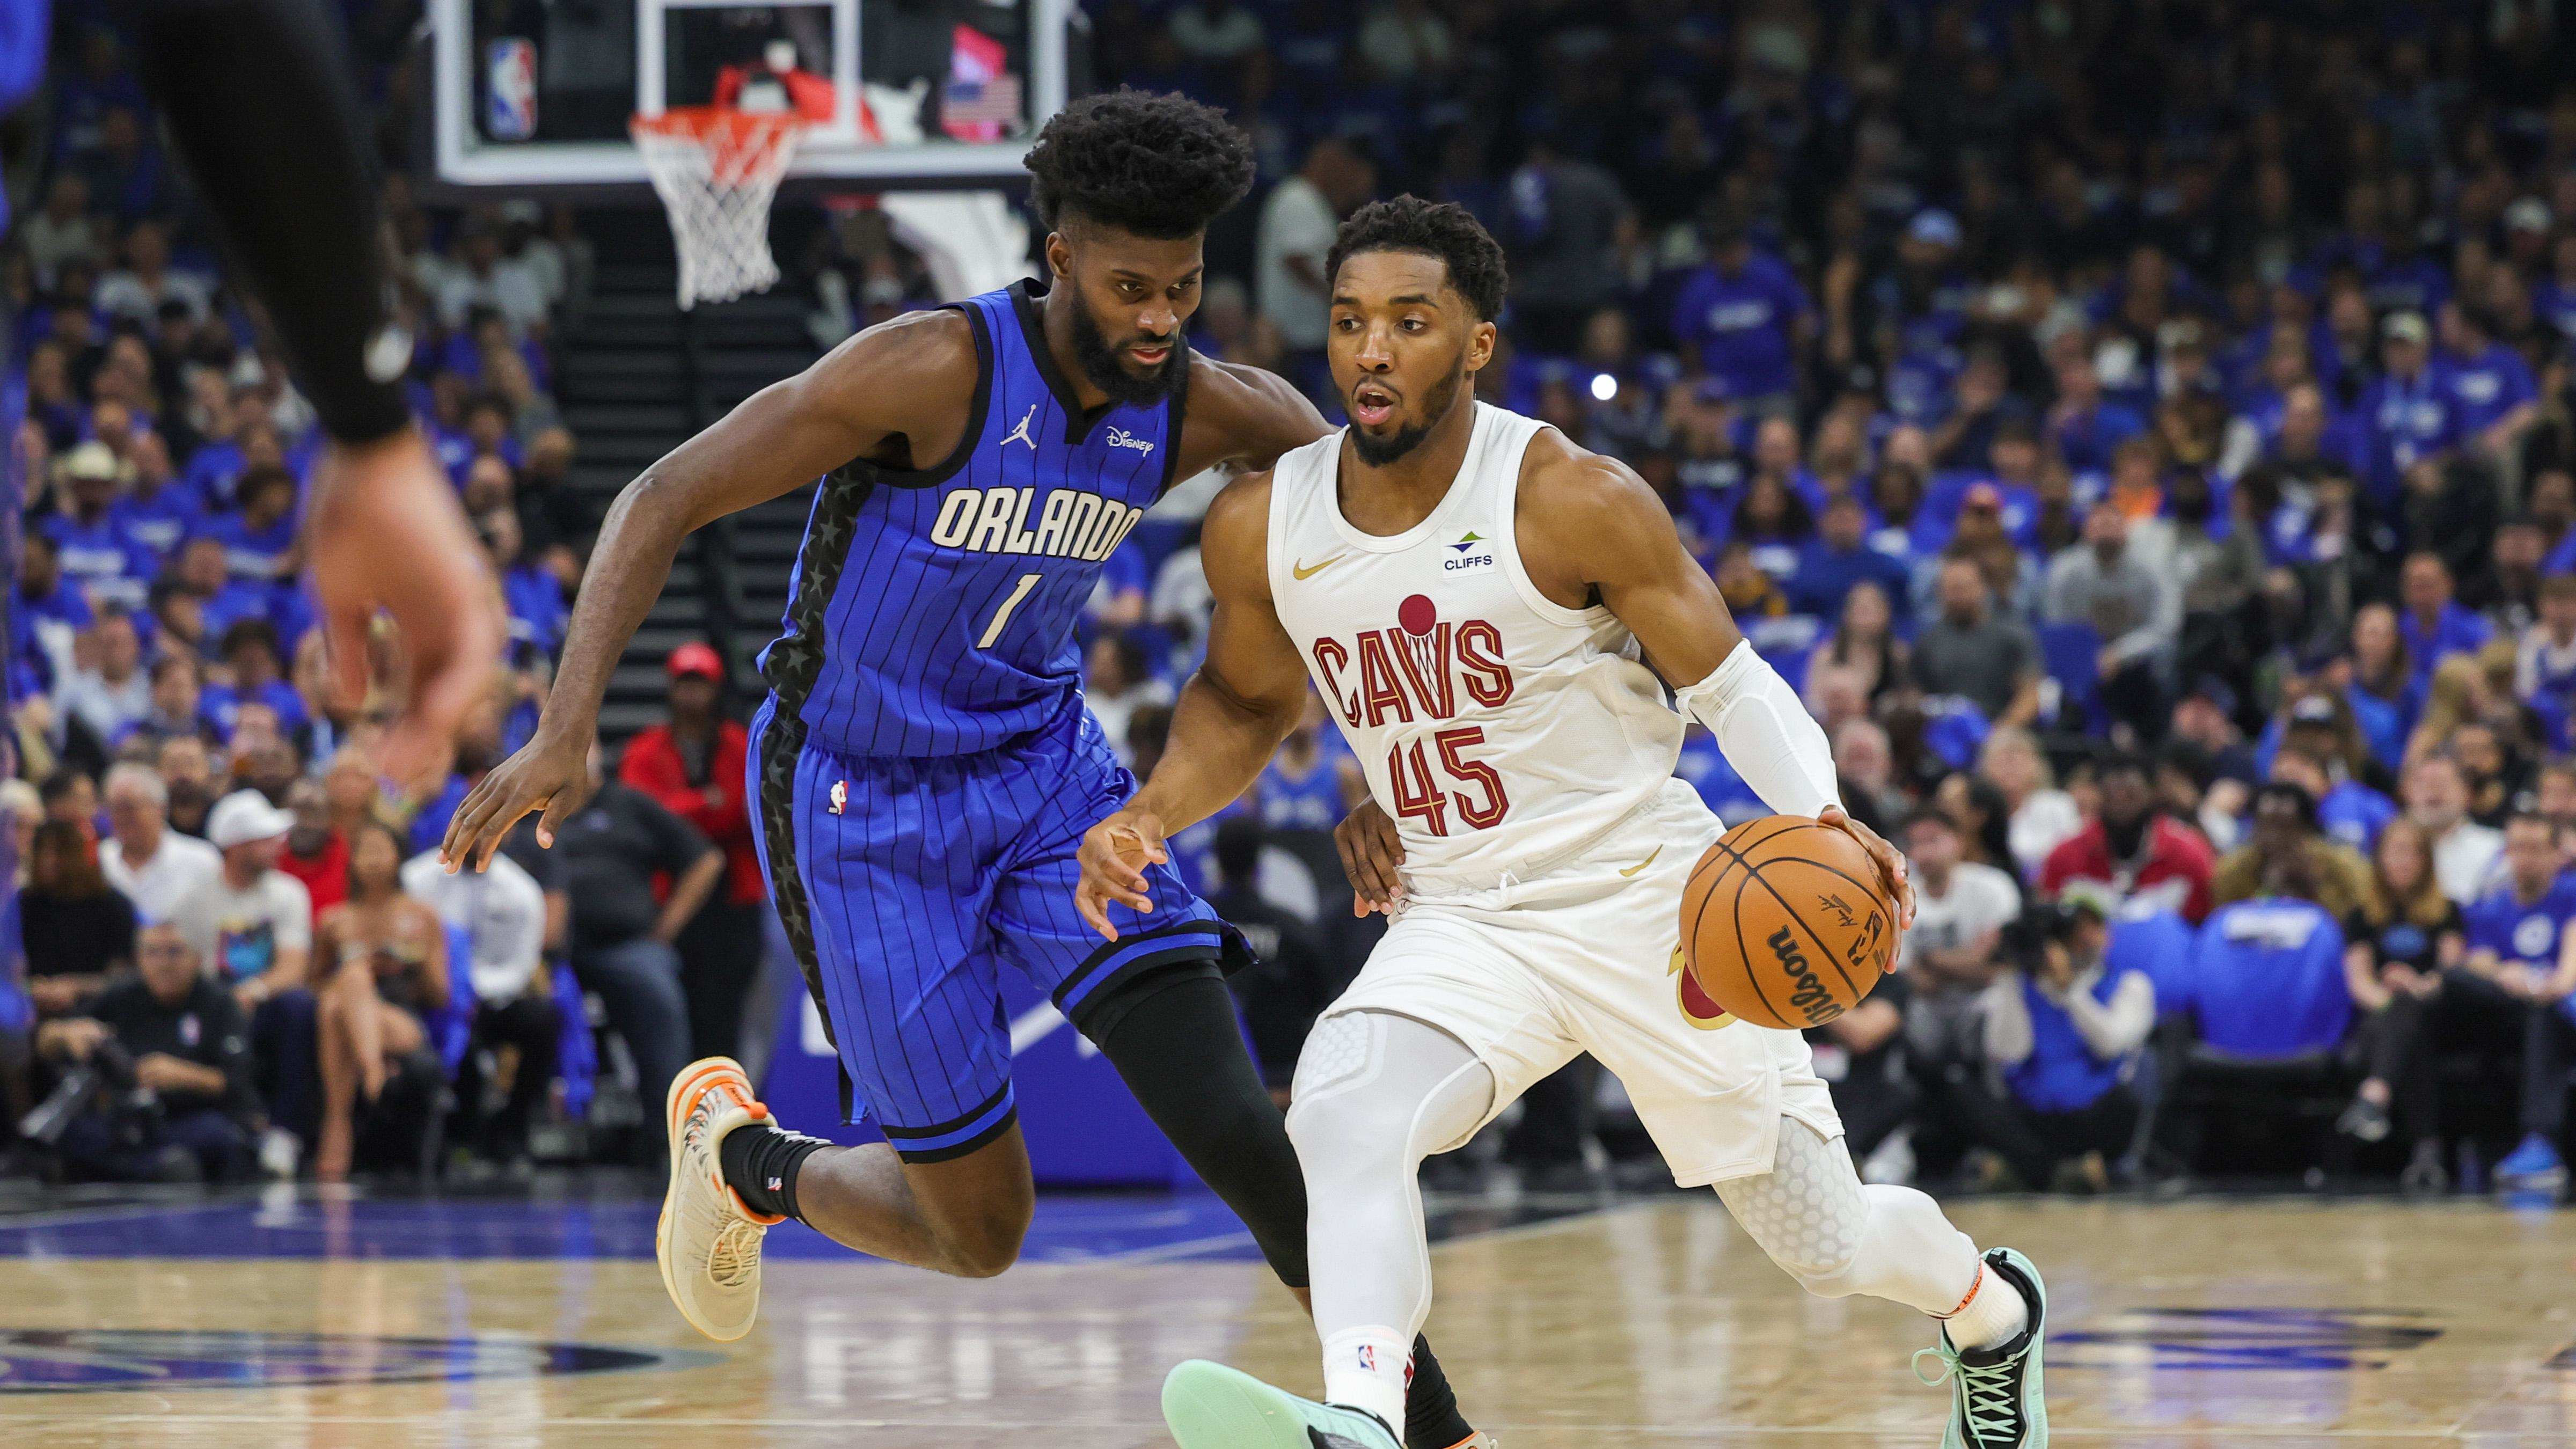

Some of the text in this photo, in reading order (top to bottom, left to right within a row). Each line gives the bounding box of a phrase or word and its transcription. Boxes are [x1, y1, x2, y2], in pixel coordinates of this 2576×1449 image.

[931, 487, 1144, 562] ORLANDO
[1445, 555, 1492, 570] CLIFFS
[976, 573, 1043, 649] 1
[1313, 618, 1514, 729] CAVS
[1388, 726, 1510, 837] 45
